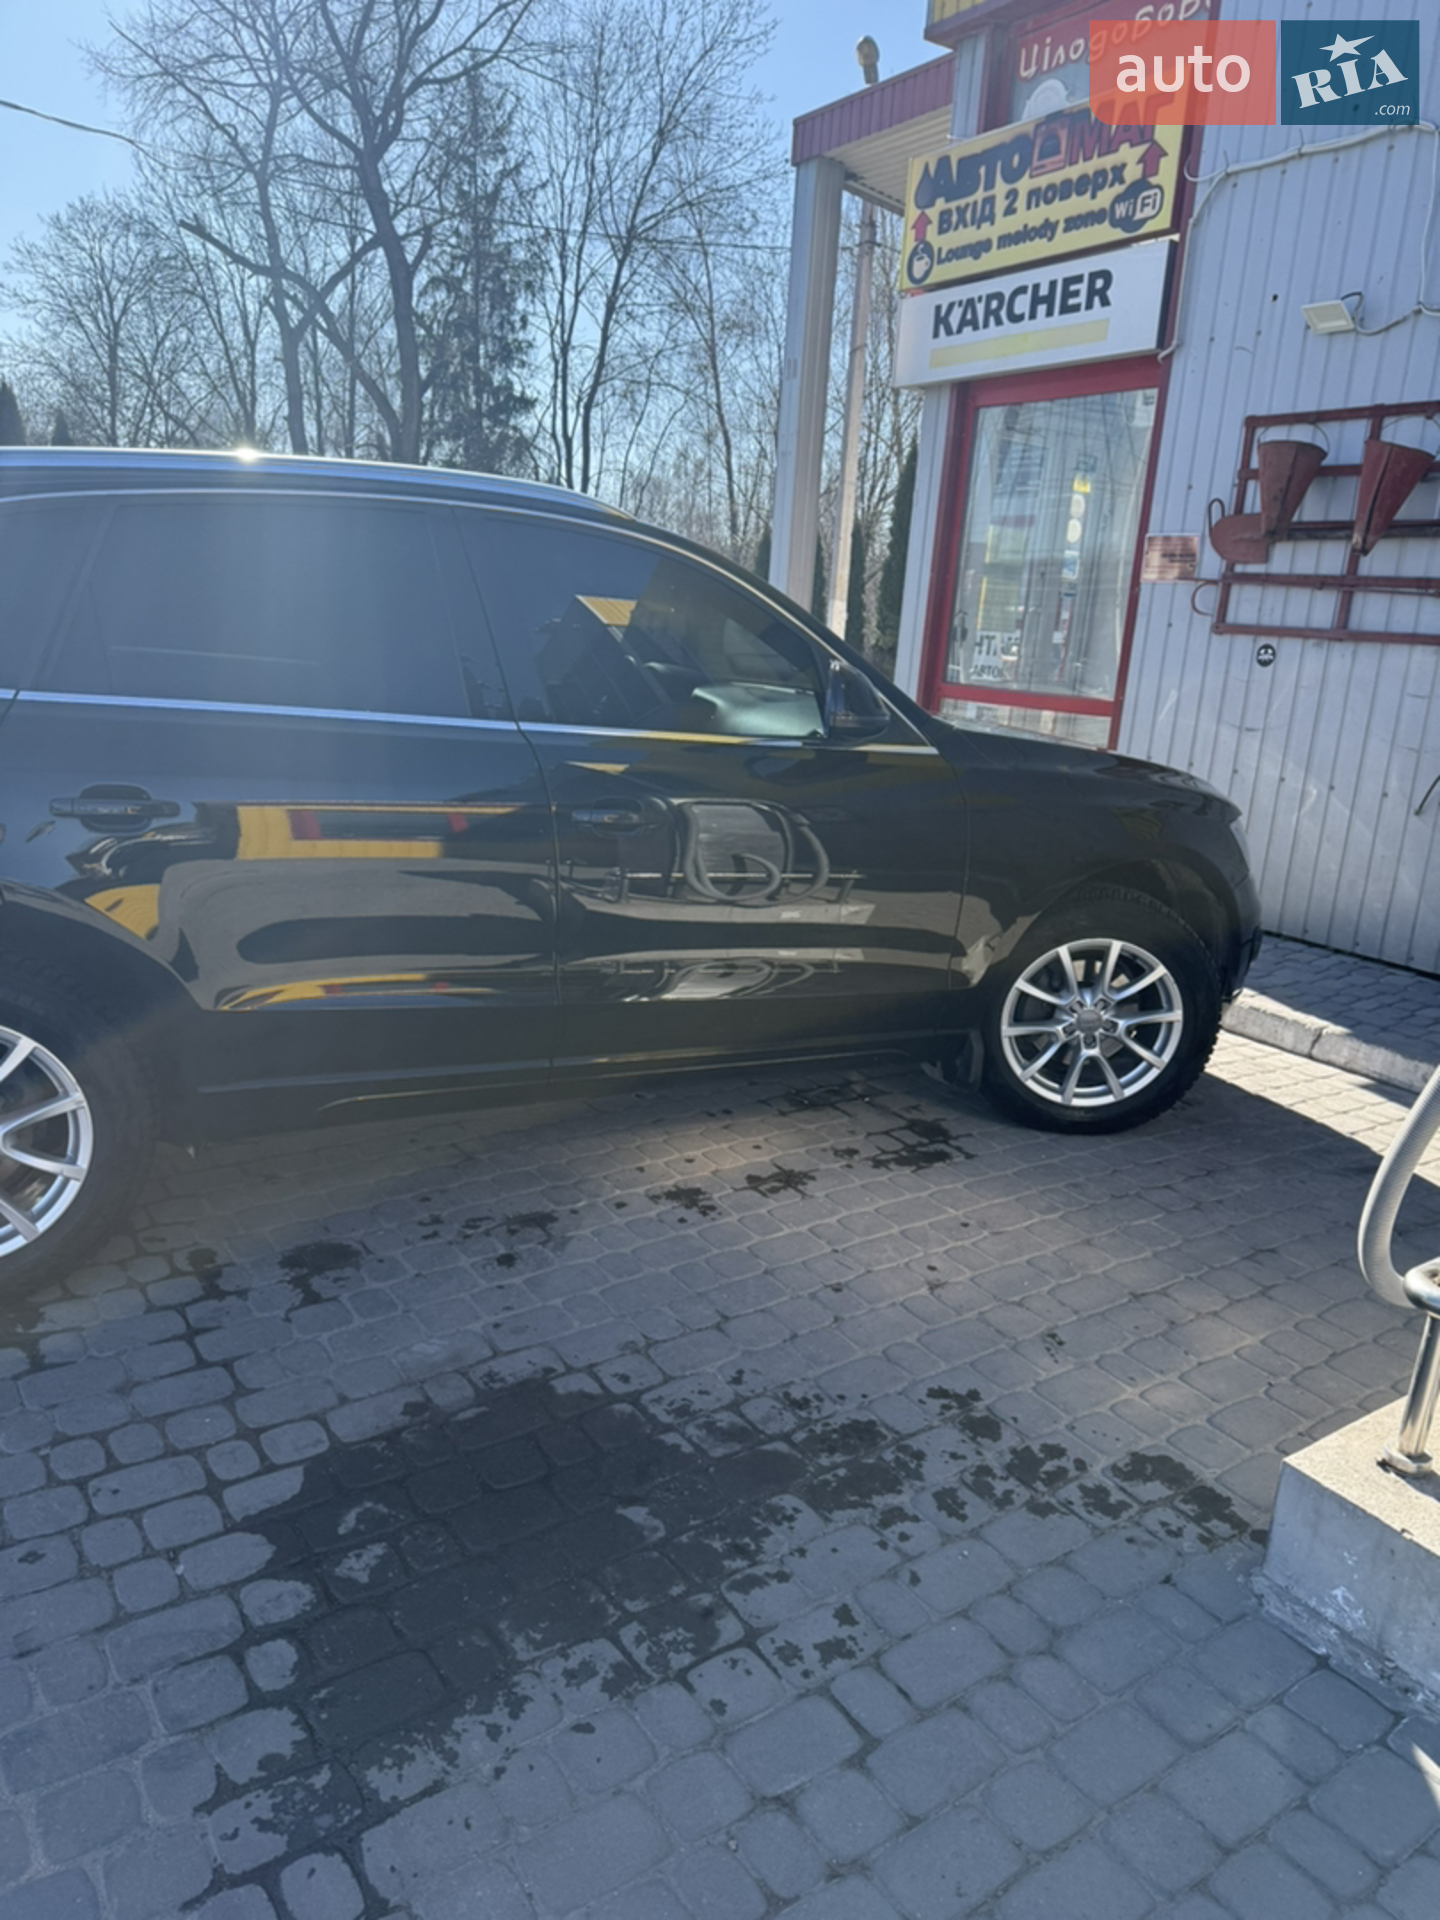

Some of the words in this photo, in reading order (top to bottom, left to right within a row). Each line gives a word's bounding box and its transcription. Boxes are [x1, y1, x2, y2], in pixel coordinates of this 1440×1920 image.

[936, 194, 997, 236] ВХІД
[1002, 186, 1019, 218] 2
[1025, 162, 1128, 212] поверх
[936, 237, 994, 266] Lounge
[996, 216, 1060, 251] melody
[1062, 207, 1108, 234] zone
[931, 268, 1114, 340] KÄRCHER
